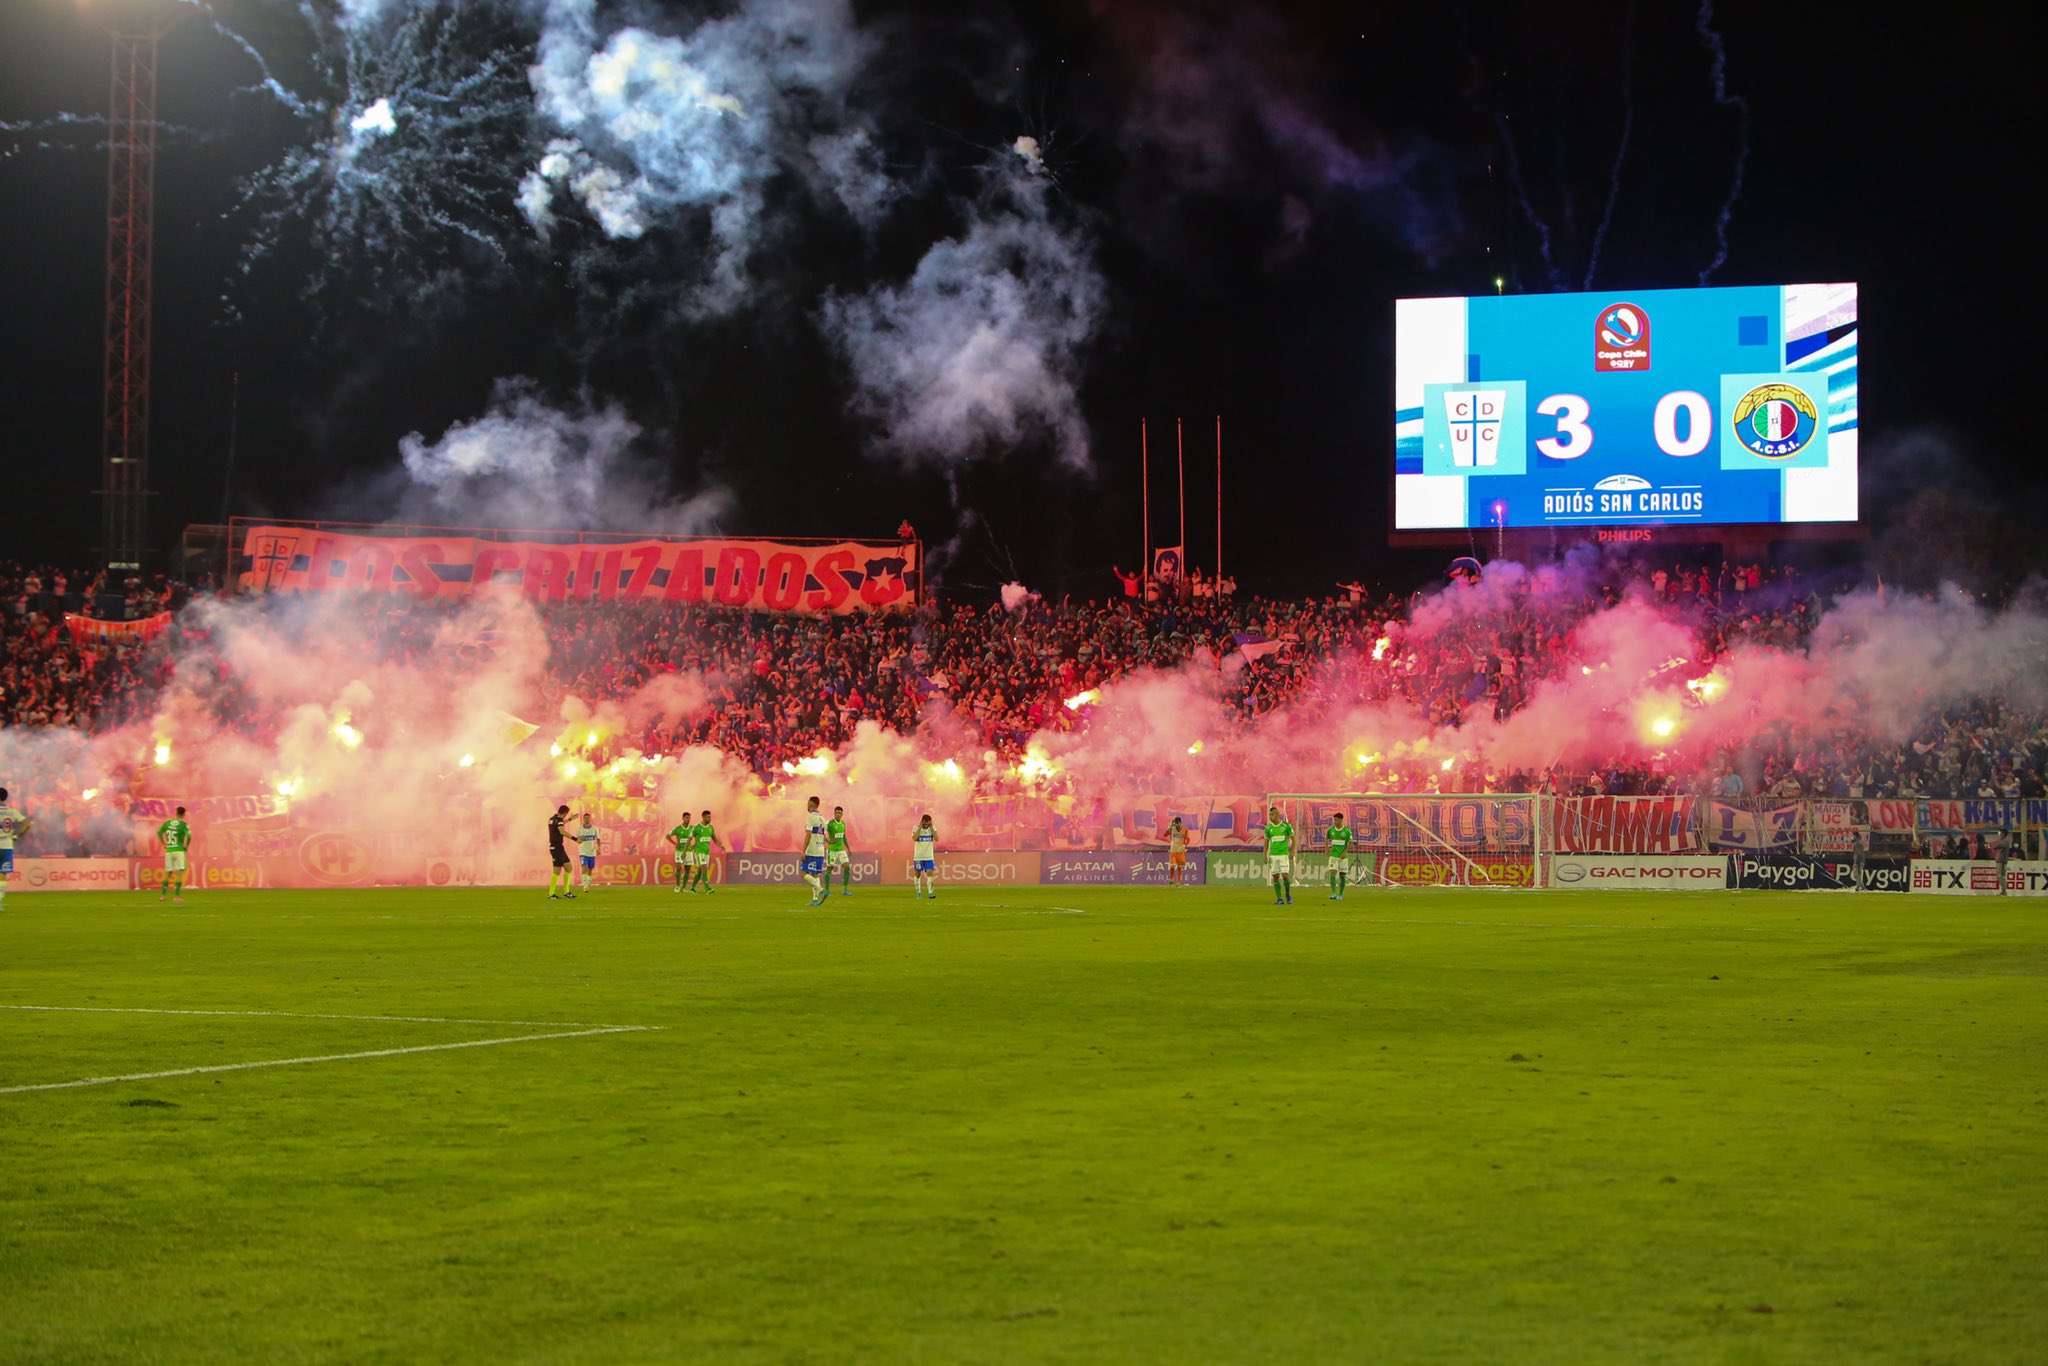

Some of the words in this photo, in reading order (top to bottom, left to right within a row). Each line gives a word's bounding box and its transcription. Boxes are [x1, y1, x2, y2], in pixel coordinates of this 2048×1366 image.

[1598, 351, 1622, 359] Copa
[1623, 350, 1647, 358] Chile
[1536, 394, 1594, 459] 3
[1653, 390, 1712, 457] 0
[1750, 440, 1800, 455] A.C.S.I.
[1544, 492, 1594, 513] ADIÓS
[1600, 494, 1632, 512] SAN
[1639, 492, 1703, 511] CARLOS
[1598, 530, 1652, 541] PHILIPS
[471, 546, 857, 610] CRUZADOS
[166, 829, 179, 845] 35
[739, 859, 800, 882] Paygol
[1065, 862, 1115, 871] LATAM
[1590, 867, 1636, 878] GAC
[1639, 867, 1722, 878] MOTOR
[1744, 861, 1814, 885] Paygol
[50, 870, 78, 881] GAC
[79, 870, 127, 881] MOTOR
[1933, 871, 1965, 888] TX
